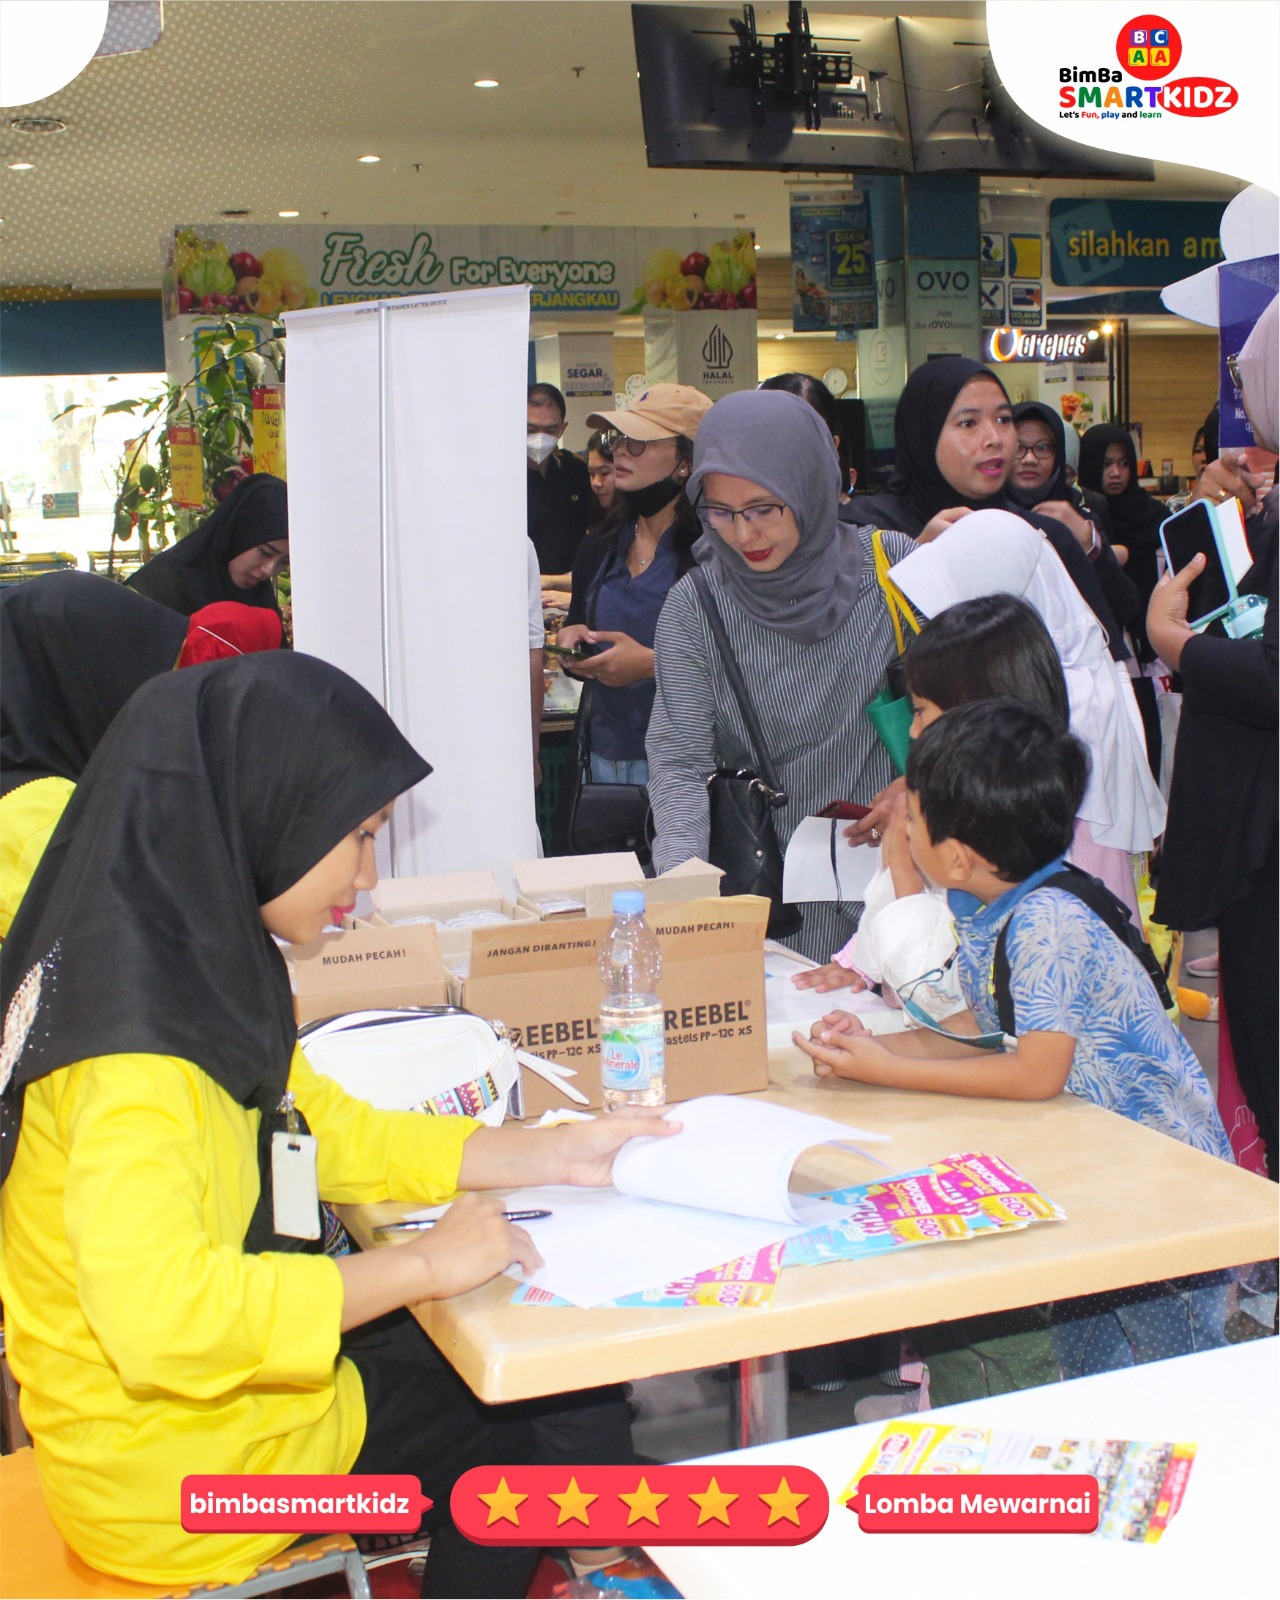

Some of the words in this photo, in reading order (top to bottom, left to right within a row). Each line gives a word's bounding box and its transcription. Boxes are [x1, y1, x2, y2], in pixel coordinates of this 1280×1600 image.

[1068, 230, 1170, 257] silahkan
[1183, 236, 1223, 258] am
[321, 231, 444, 286] Fresh
[450, 257, 497, 284] For
[498, 257, 615, 289] Everyone
[917, 271, 969, 291] OVO
[530, 292, 618, 307] RJANGKAU
[567, 368, 603, 379] SEGAR
[656, 925, 695, 935] MUDAH
[697, 921, 735, 932] PECAH!
[487, 946, 530, 957] JANGAN
[532, 940, 596, 952] DIBANTING!
[322, 953, 363, 965] MUDAH
[366, 949, 406, 960] PECAH!
[664, 1000, 748, 1030] REEBEL
[664, 1033, 698, 1045] astels
[611, 1049, 623, 1060] Le
[603, 1057, 640, 1069] Minerale
